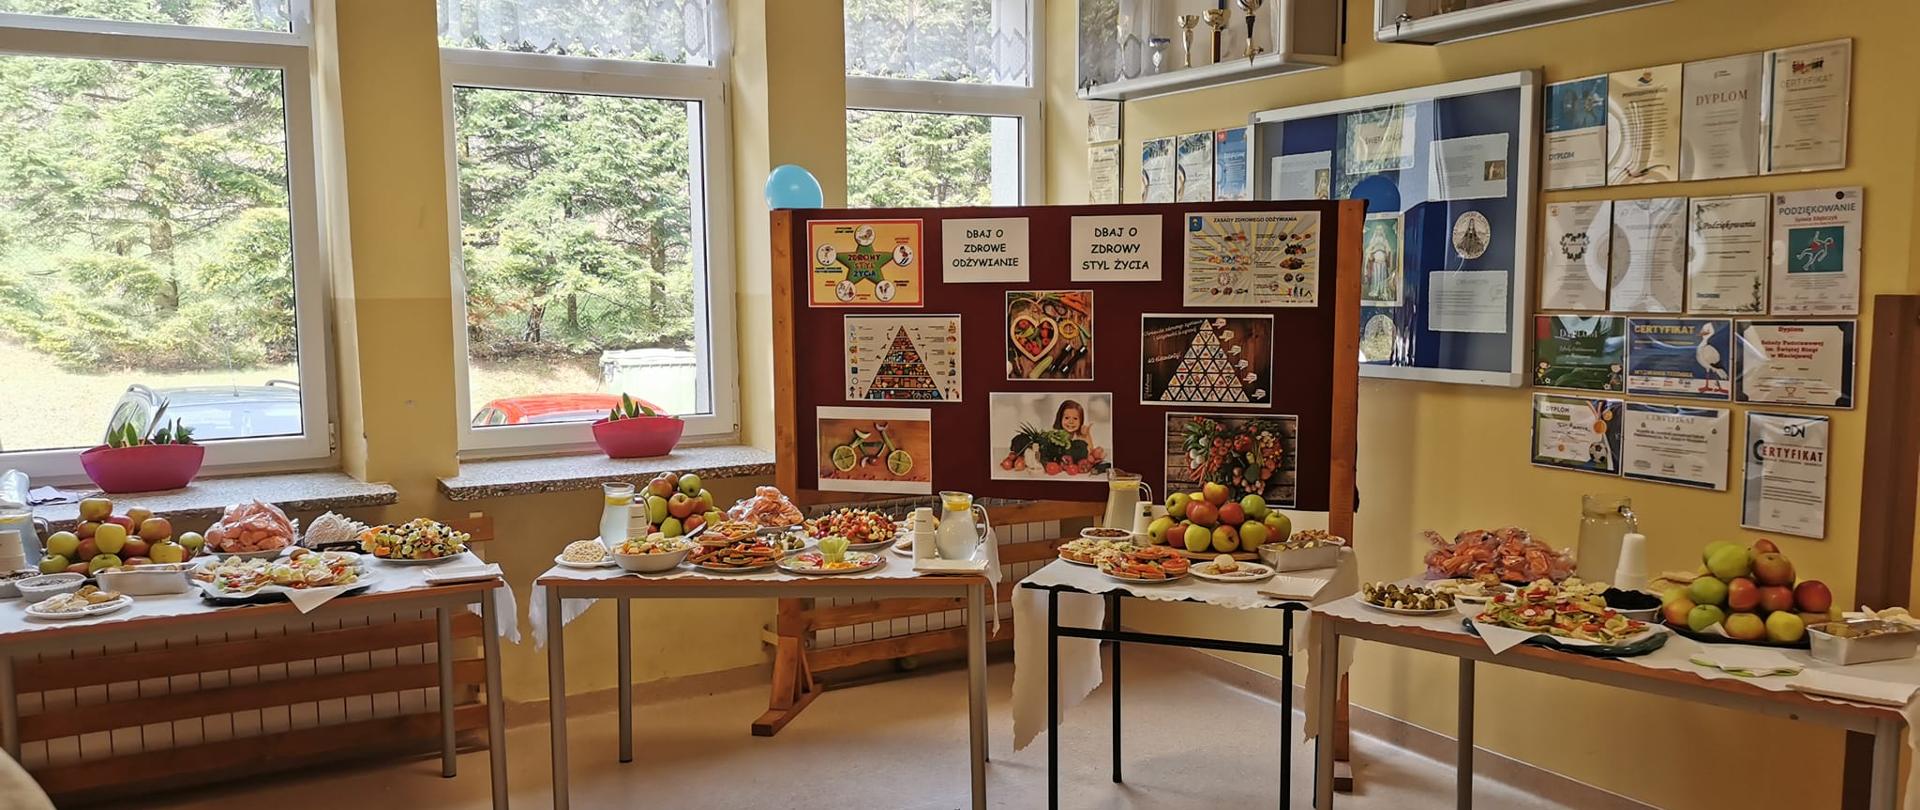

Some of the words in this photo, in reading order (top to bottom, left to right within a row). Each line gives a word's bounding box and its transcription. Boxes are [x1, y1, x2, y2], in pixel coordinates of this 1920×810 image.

[1695, 89, 1748, 106] DYPLOM
[1779, 203, 1857, 216] PODZIĘKOWANIE
[966, 229, 992, 238] DBAJ
[995, 229, 1004, 238] O
[1094, 227, 1126, 238] DBAJ
[1128, 227, 1138, 237] O
[963, 243, 1007, 253] ZDROWE
[1090, 243, 1141, 254] ZDROWY
[952, 256, 1019, 268] ODŻYWIANIE
[1082, 260, 1110, 270] STYL
[1114, 258, 1150, 270] ŻYCIA
[1634, 325, 1696, 334] CERTYFIKAT
[1753, 439, 1824, 463] CERTYFIKAT
